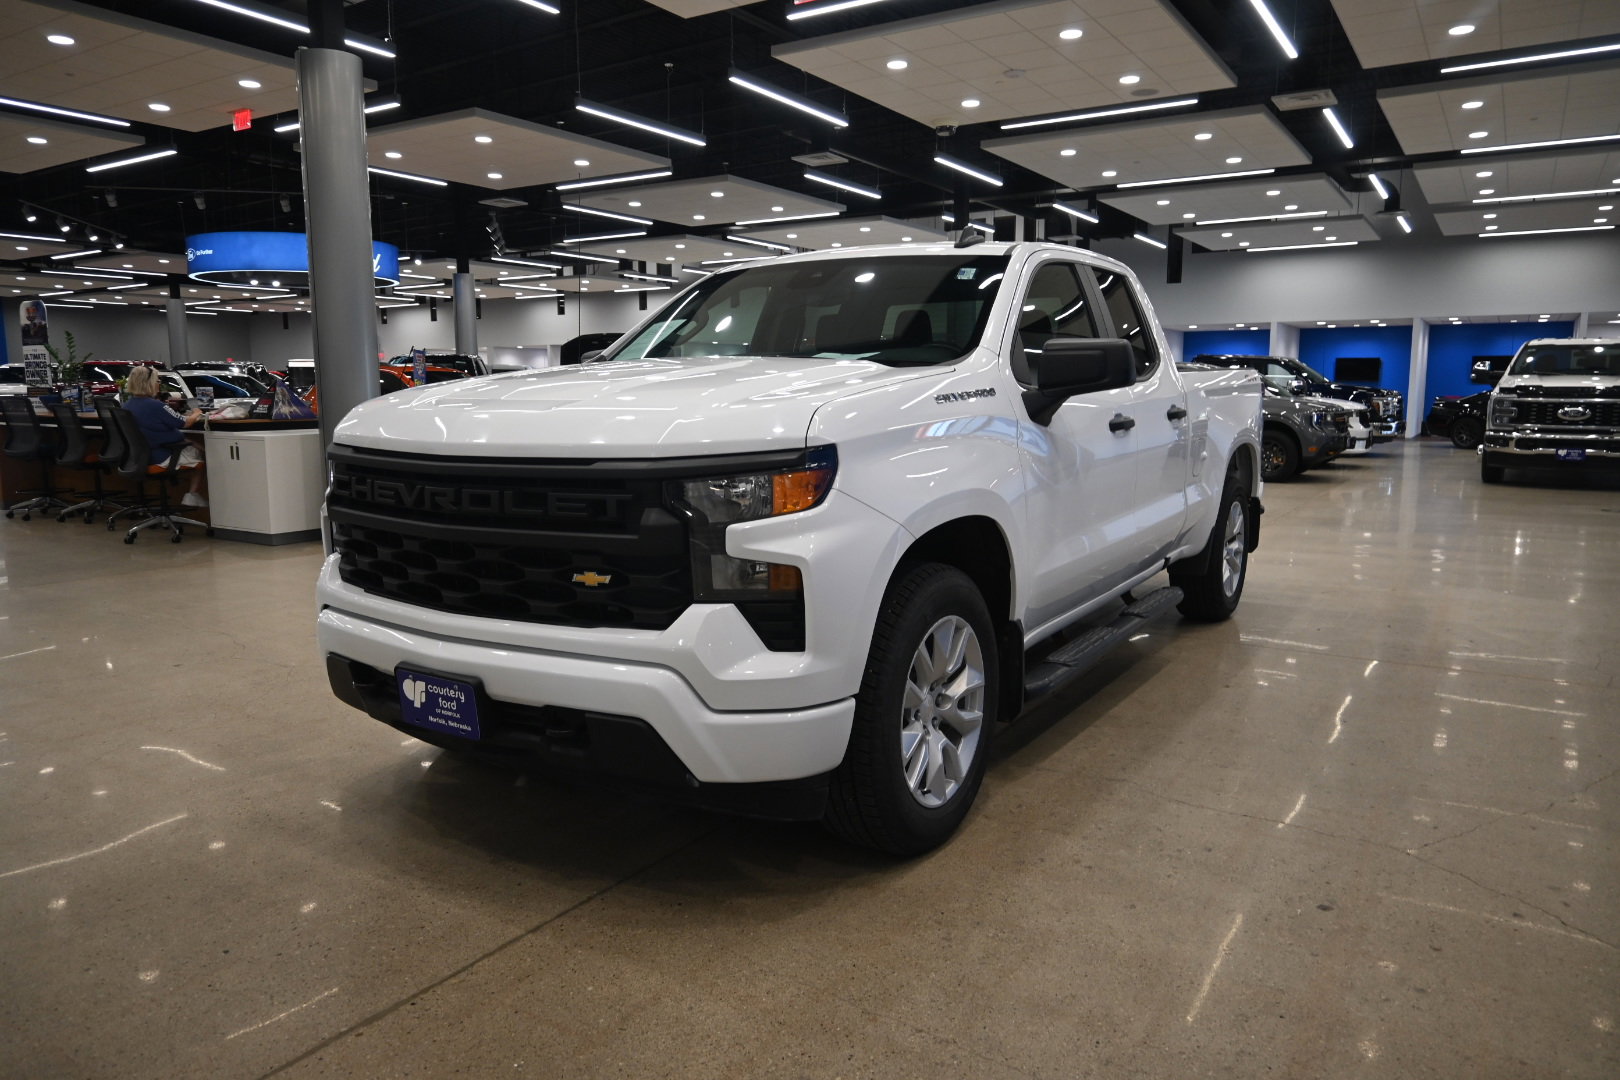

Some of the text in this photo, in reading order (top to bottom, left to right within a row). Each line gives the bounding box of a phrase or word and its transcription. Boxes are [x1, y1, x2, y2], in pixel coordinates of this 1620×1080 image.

[24, 353, 47, 361] ULTIMATE
[25, 361, 47, 369] BRONCO
[26, 369, 48, 379] OWNER
[934, 387, 997, 405] SILVERADO
[334, 473, 633, 522] CHEVROLET
[438, 697, 457, 710] ford
